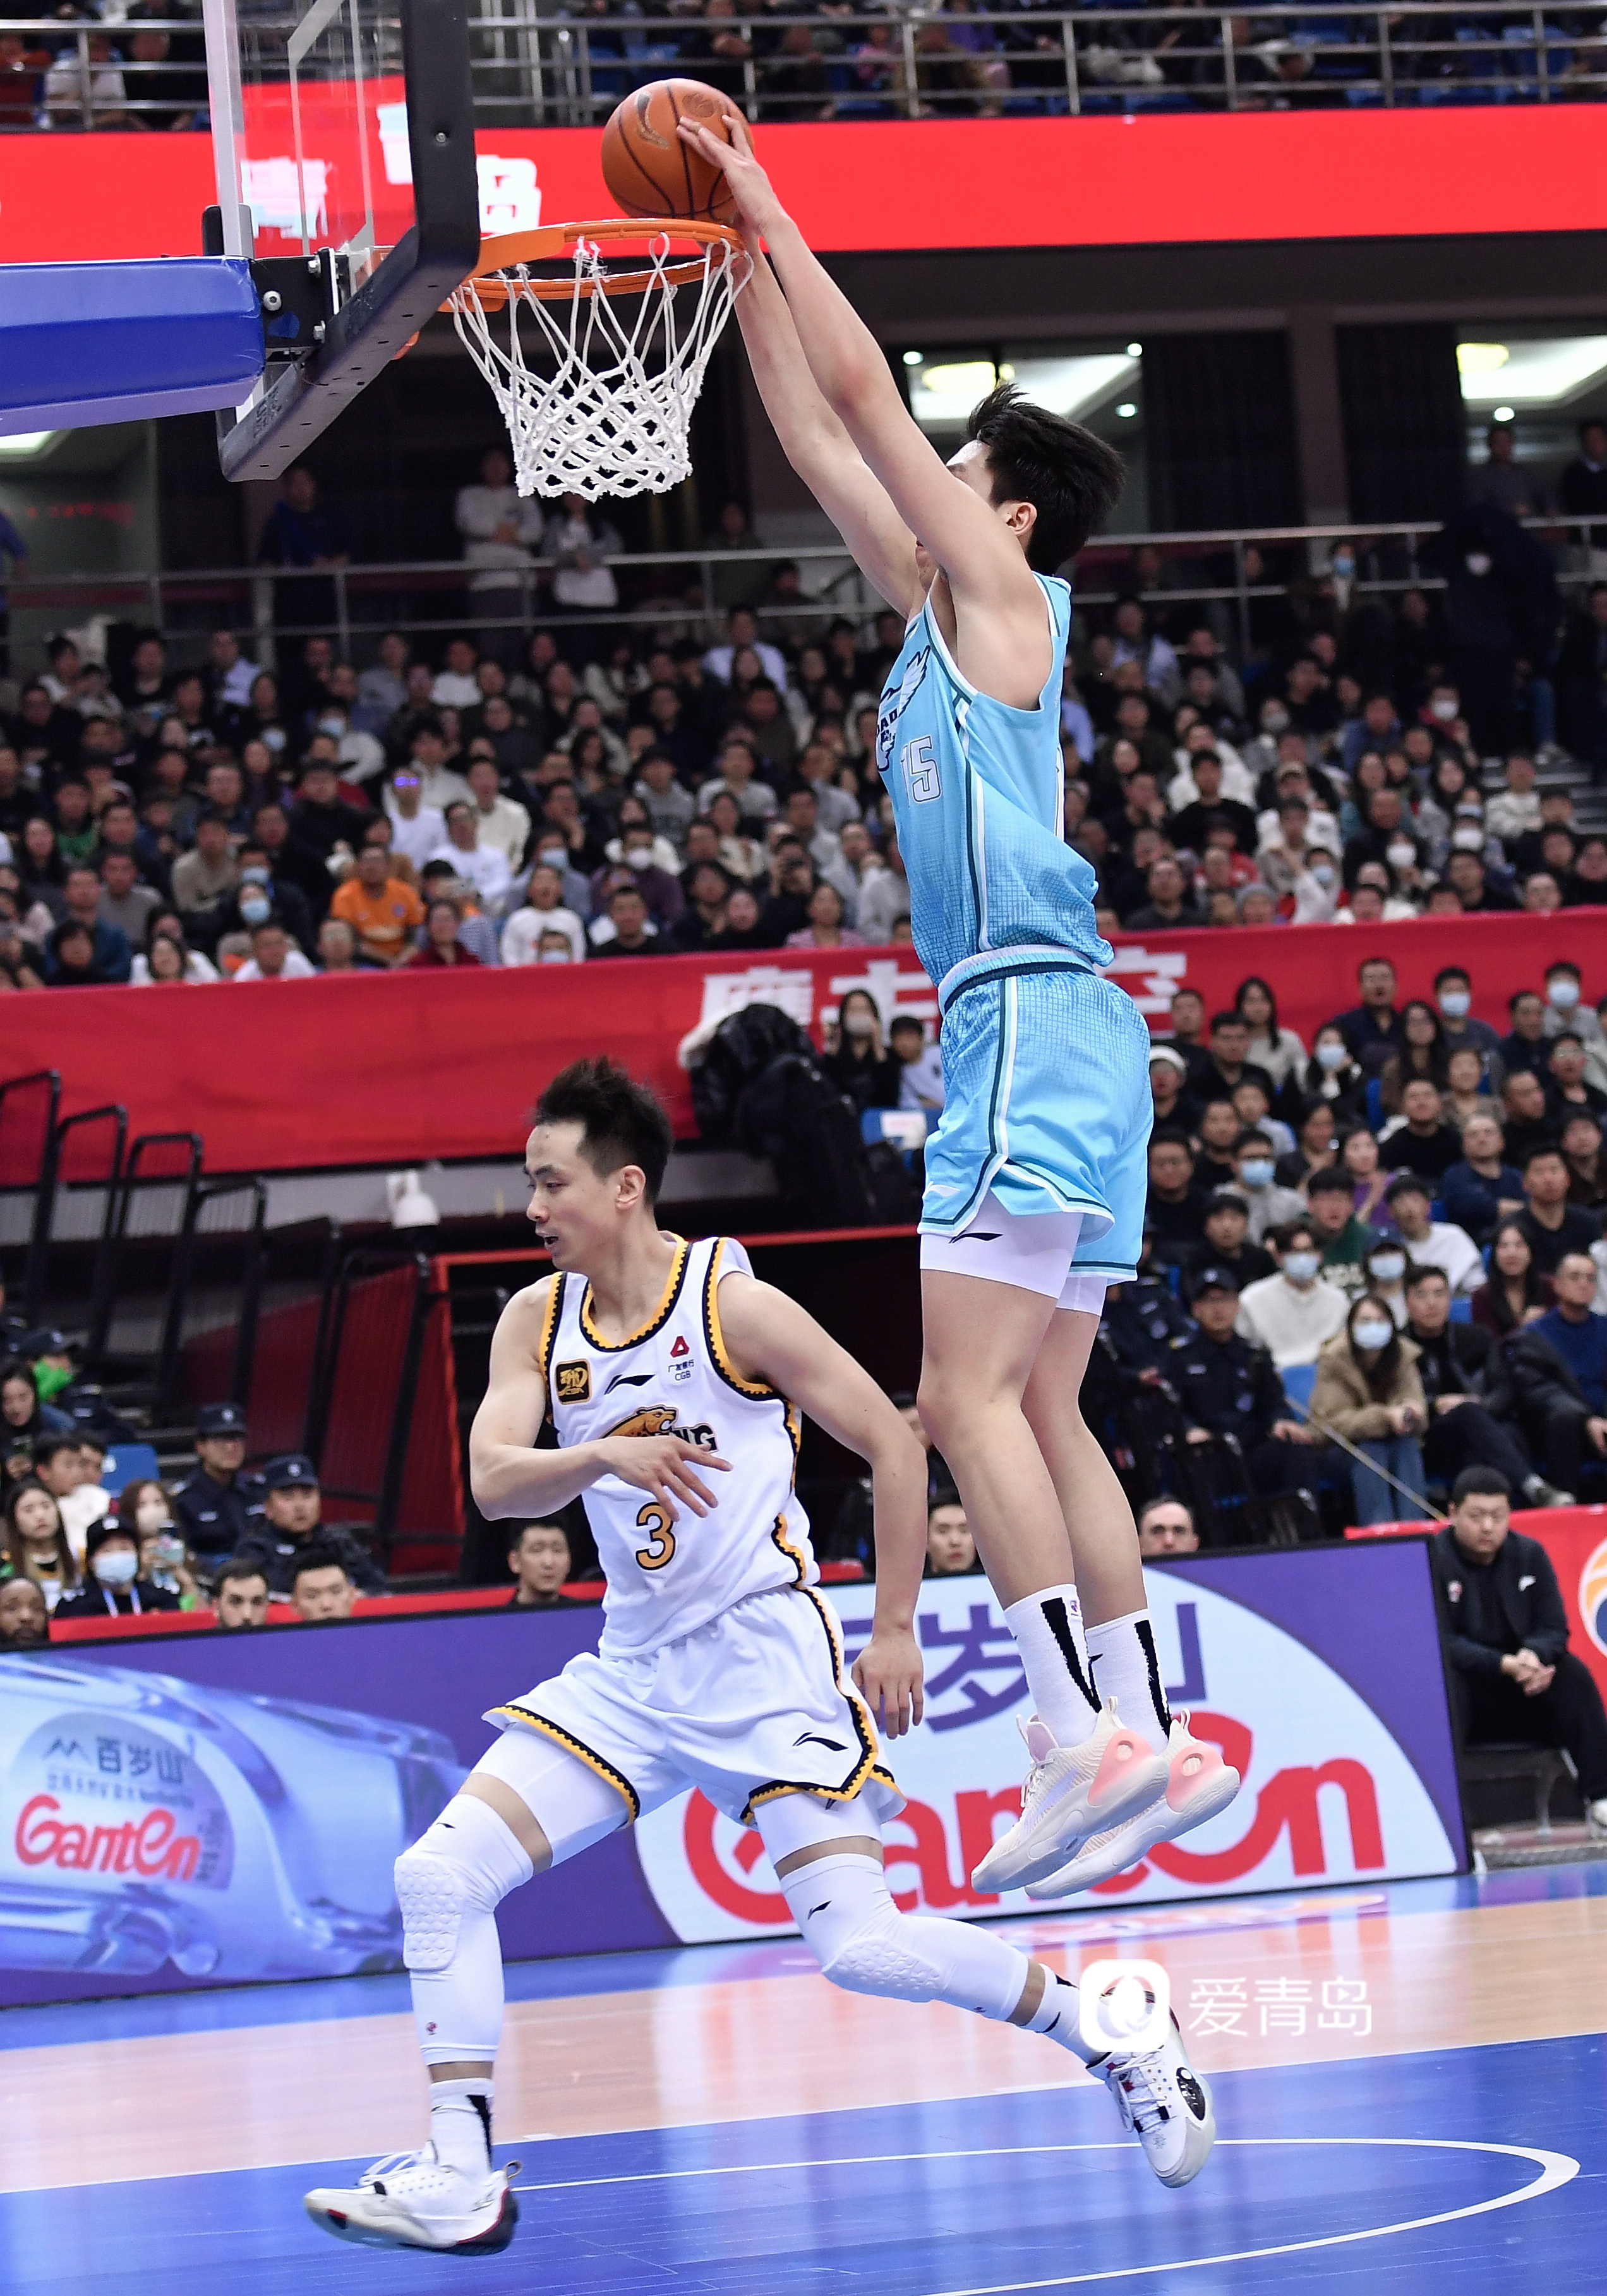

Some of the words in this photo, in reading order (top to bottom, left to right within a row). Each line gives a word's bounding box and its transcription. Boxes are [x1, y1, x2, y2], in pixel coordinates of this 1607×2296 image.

[675, 1370, 691, 1381] CGB
[635, 1502, 676, 1570] 3
[96, 1736, 188, 1784] 百岁山
[15, 1793, 200, 1881] Ganten
